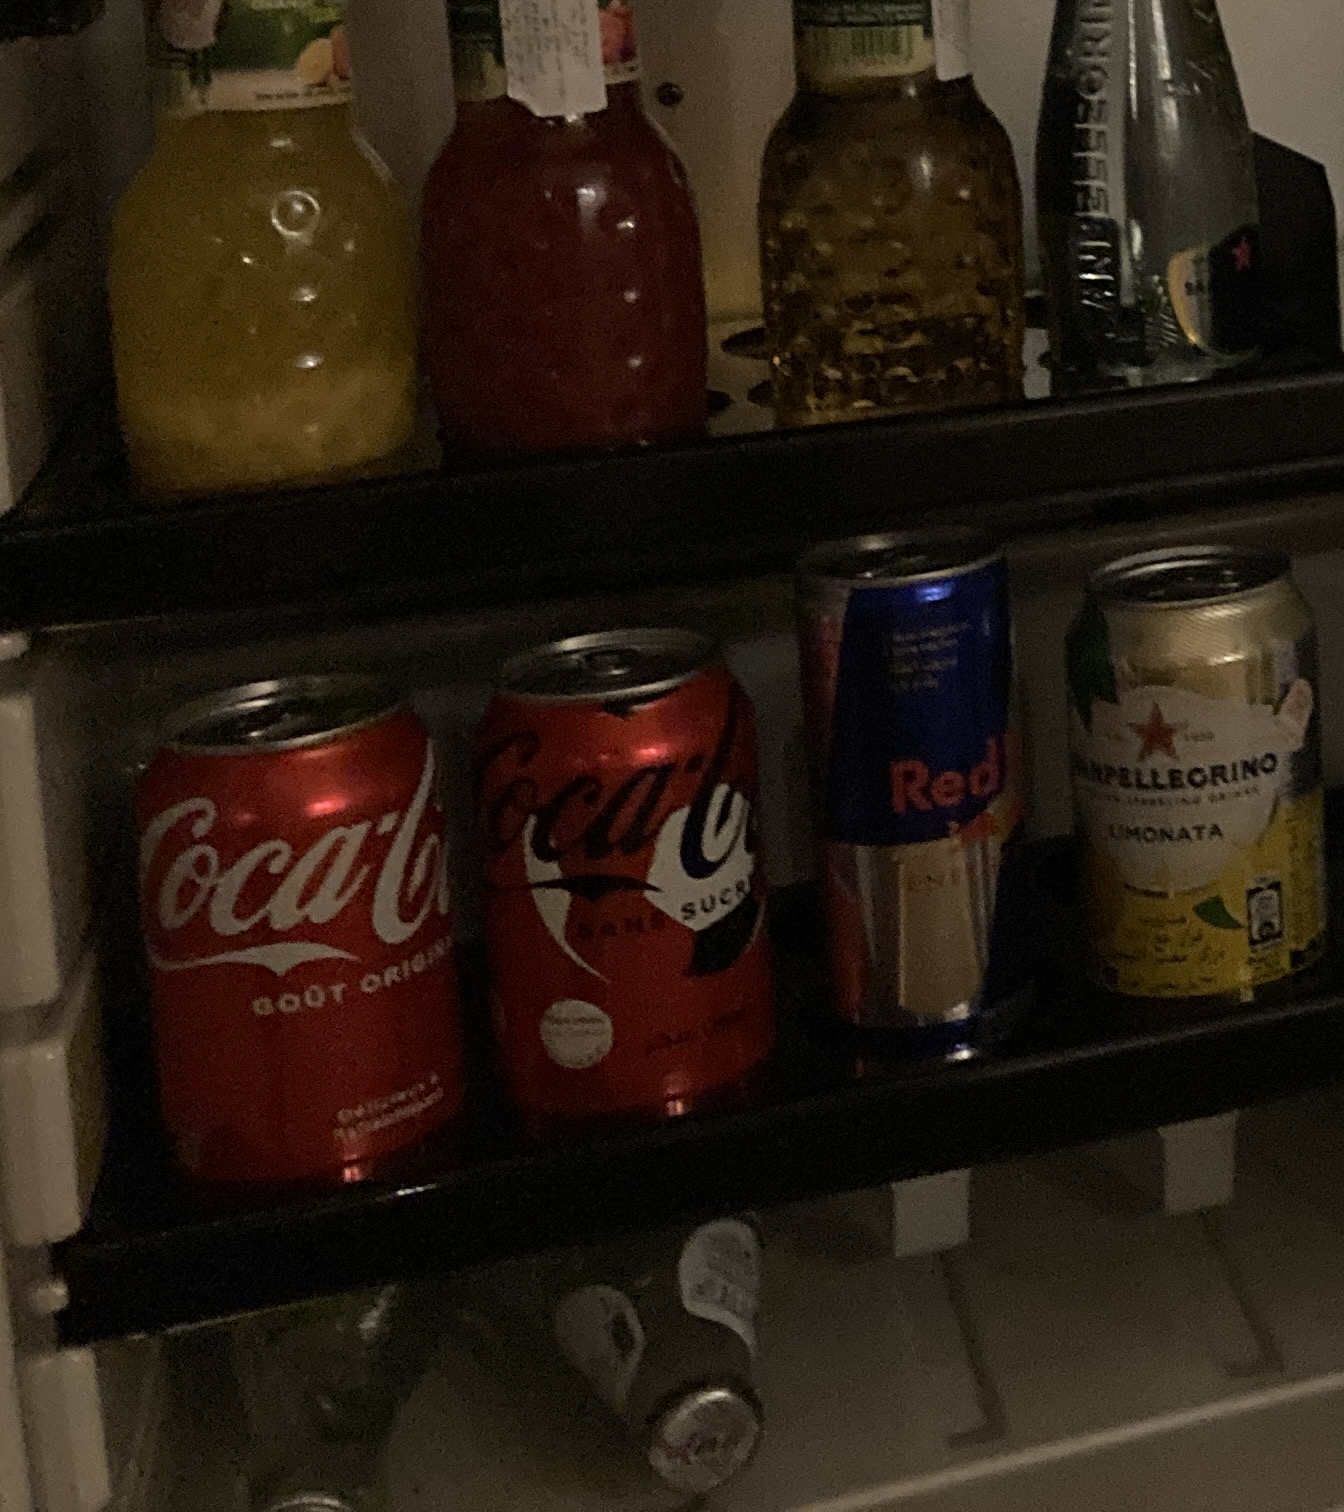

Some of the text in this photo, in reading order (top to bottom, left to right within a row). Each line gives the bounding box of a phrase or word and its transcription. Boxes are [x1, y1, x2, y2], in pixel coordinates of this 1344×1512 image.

[888, 736, 1002, 815] Red
[1105, 822, 1224, 844] LIMONATA
[681, 880, 752, 922] SUCR
[251, 981, 348, 1017] GOÛT
